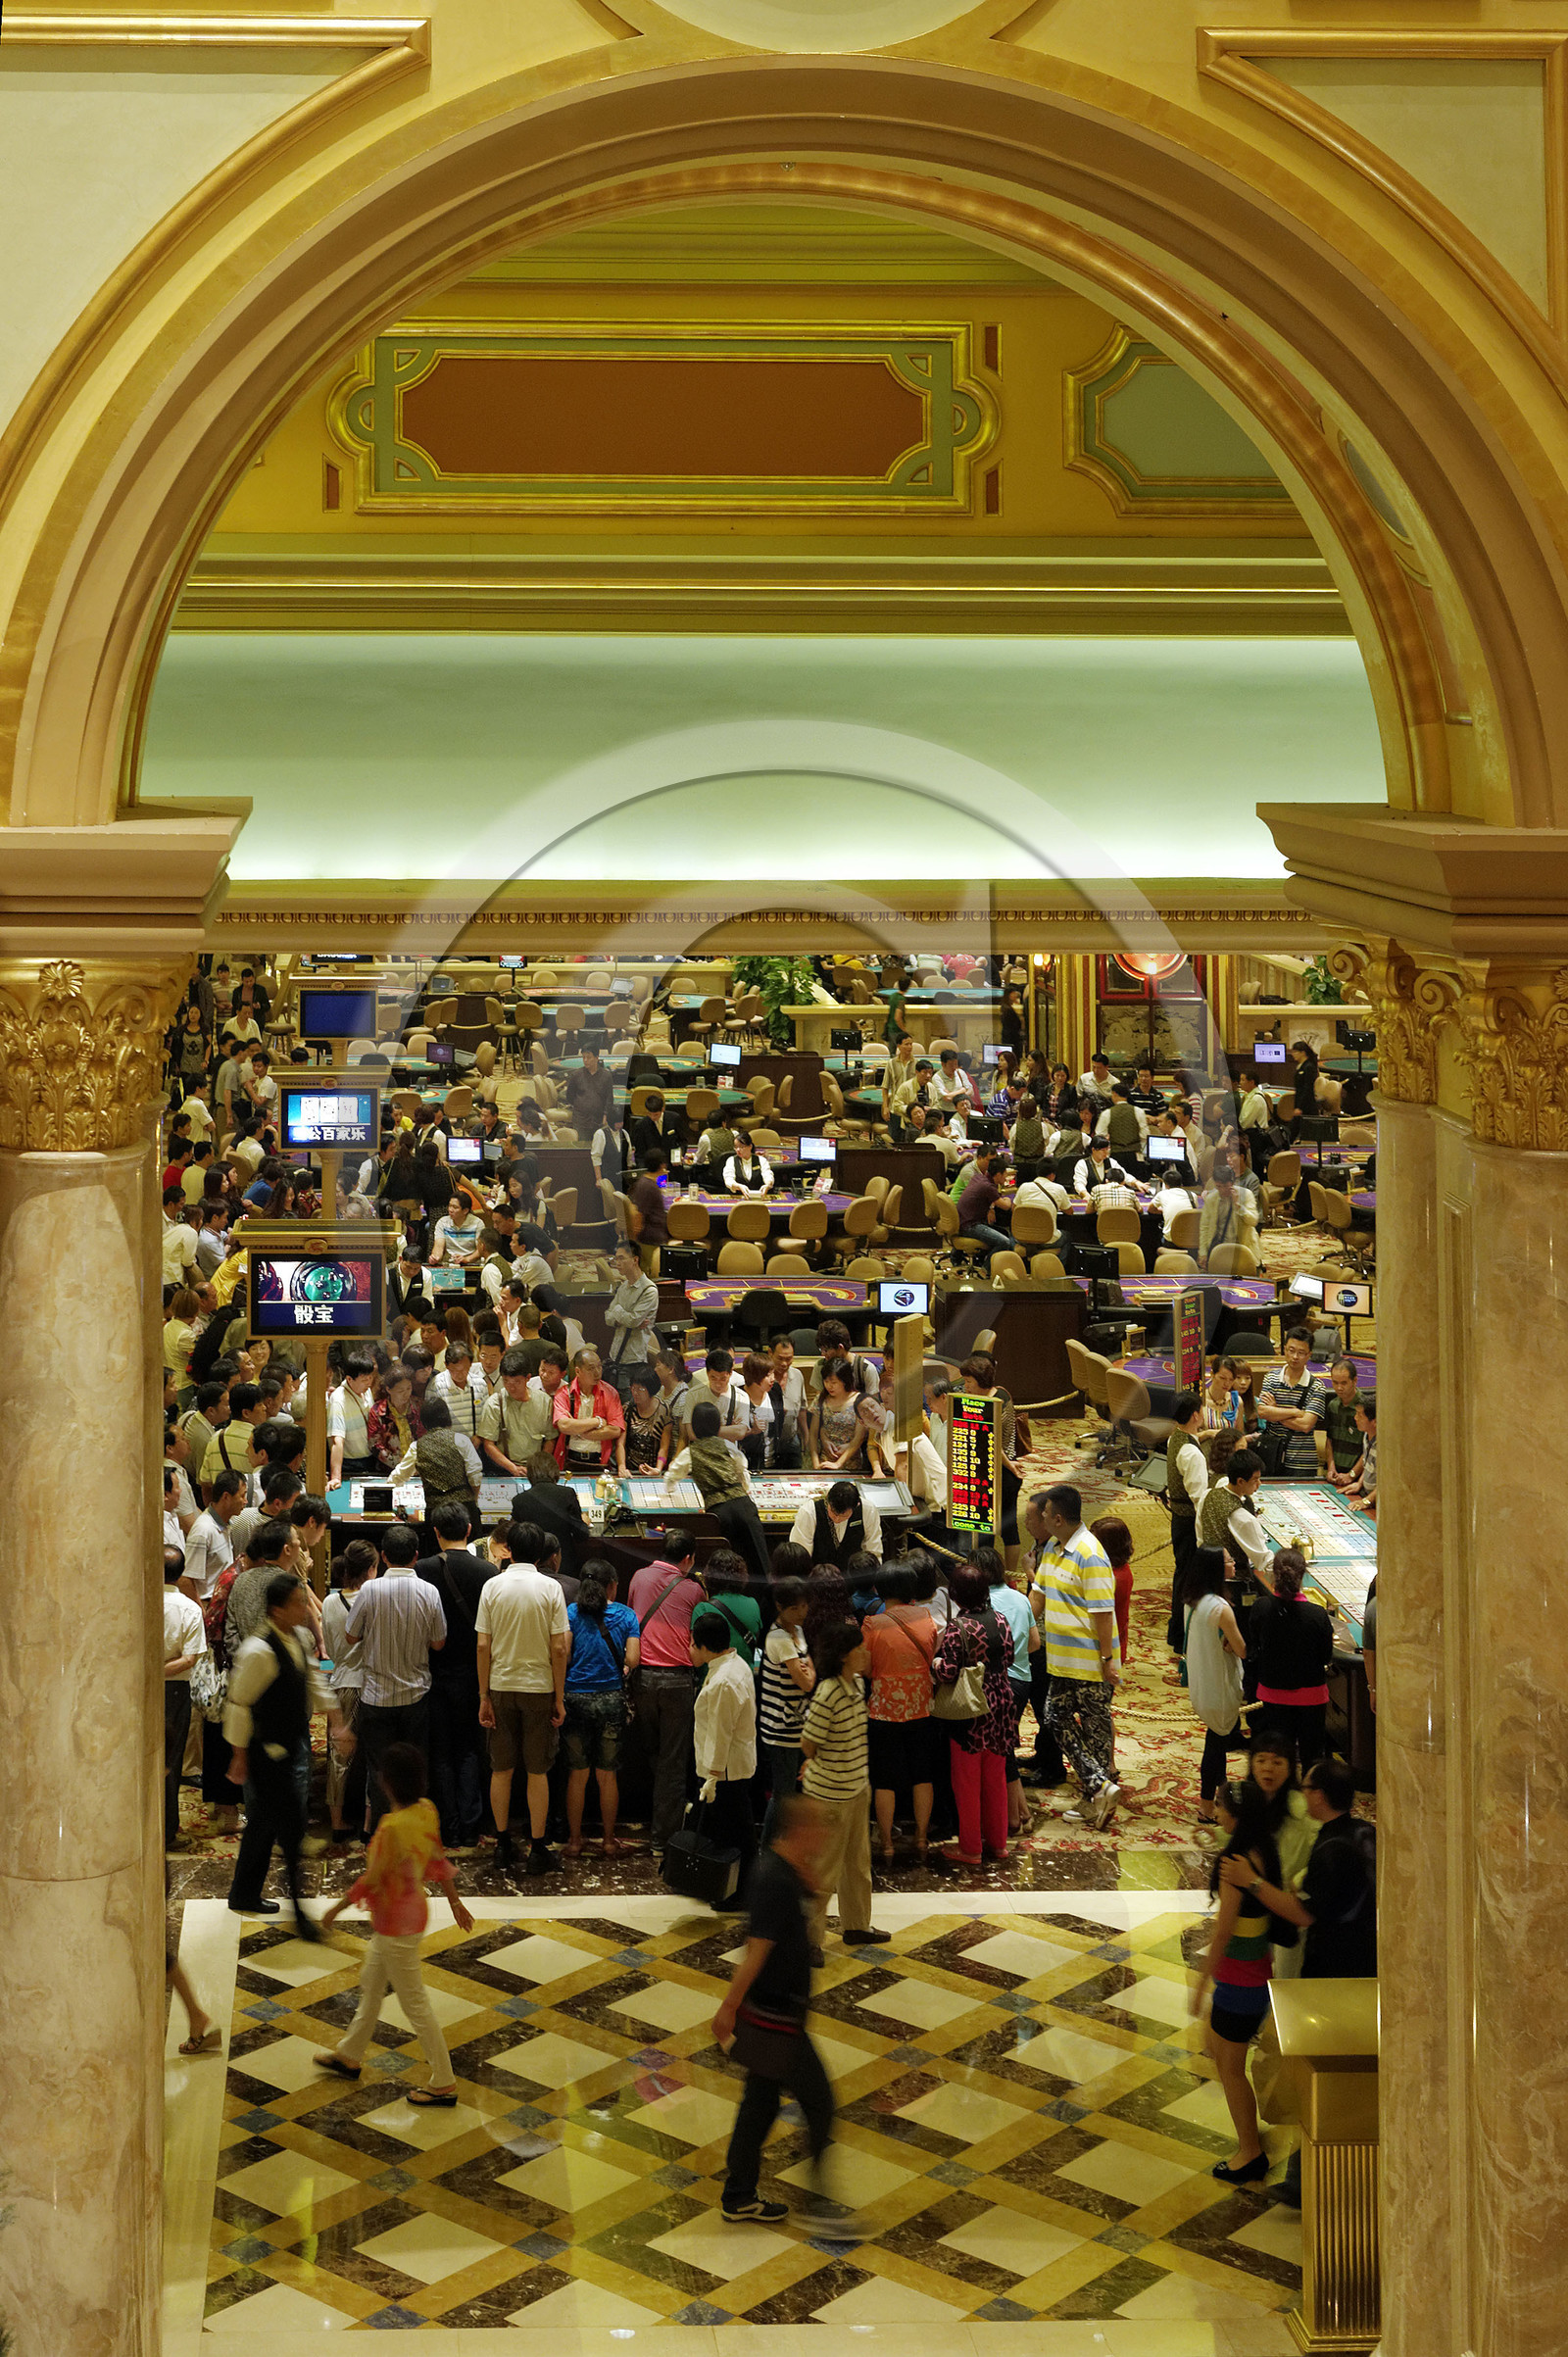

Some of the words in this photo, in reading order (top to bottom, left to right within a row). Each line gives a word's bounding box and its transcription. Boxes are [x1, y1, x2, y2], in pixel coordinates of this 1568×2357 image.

[294, 1304, 334, 1325] 骰宝
[961, 1398, 985, 1407] Place
[962, 1405, 984, 1414] Your
[591, 1509, 602, 1518] 349
